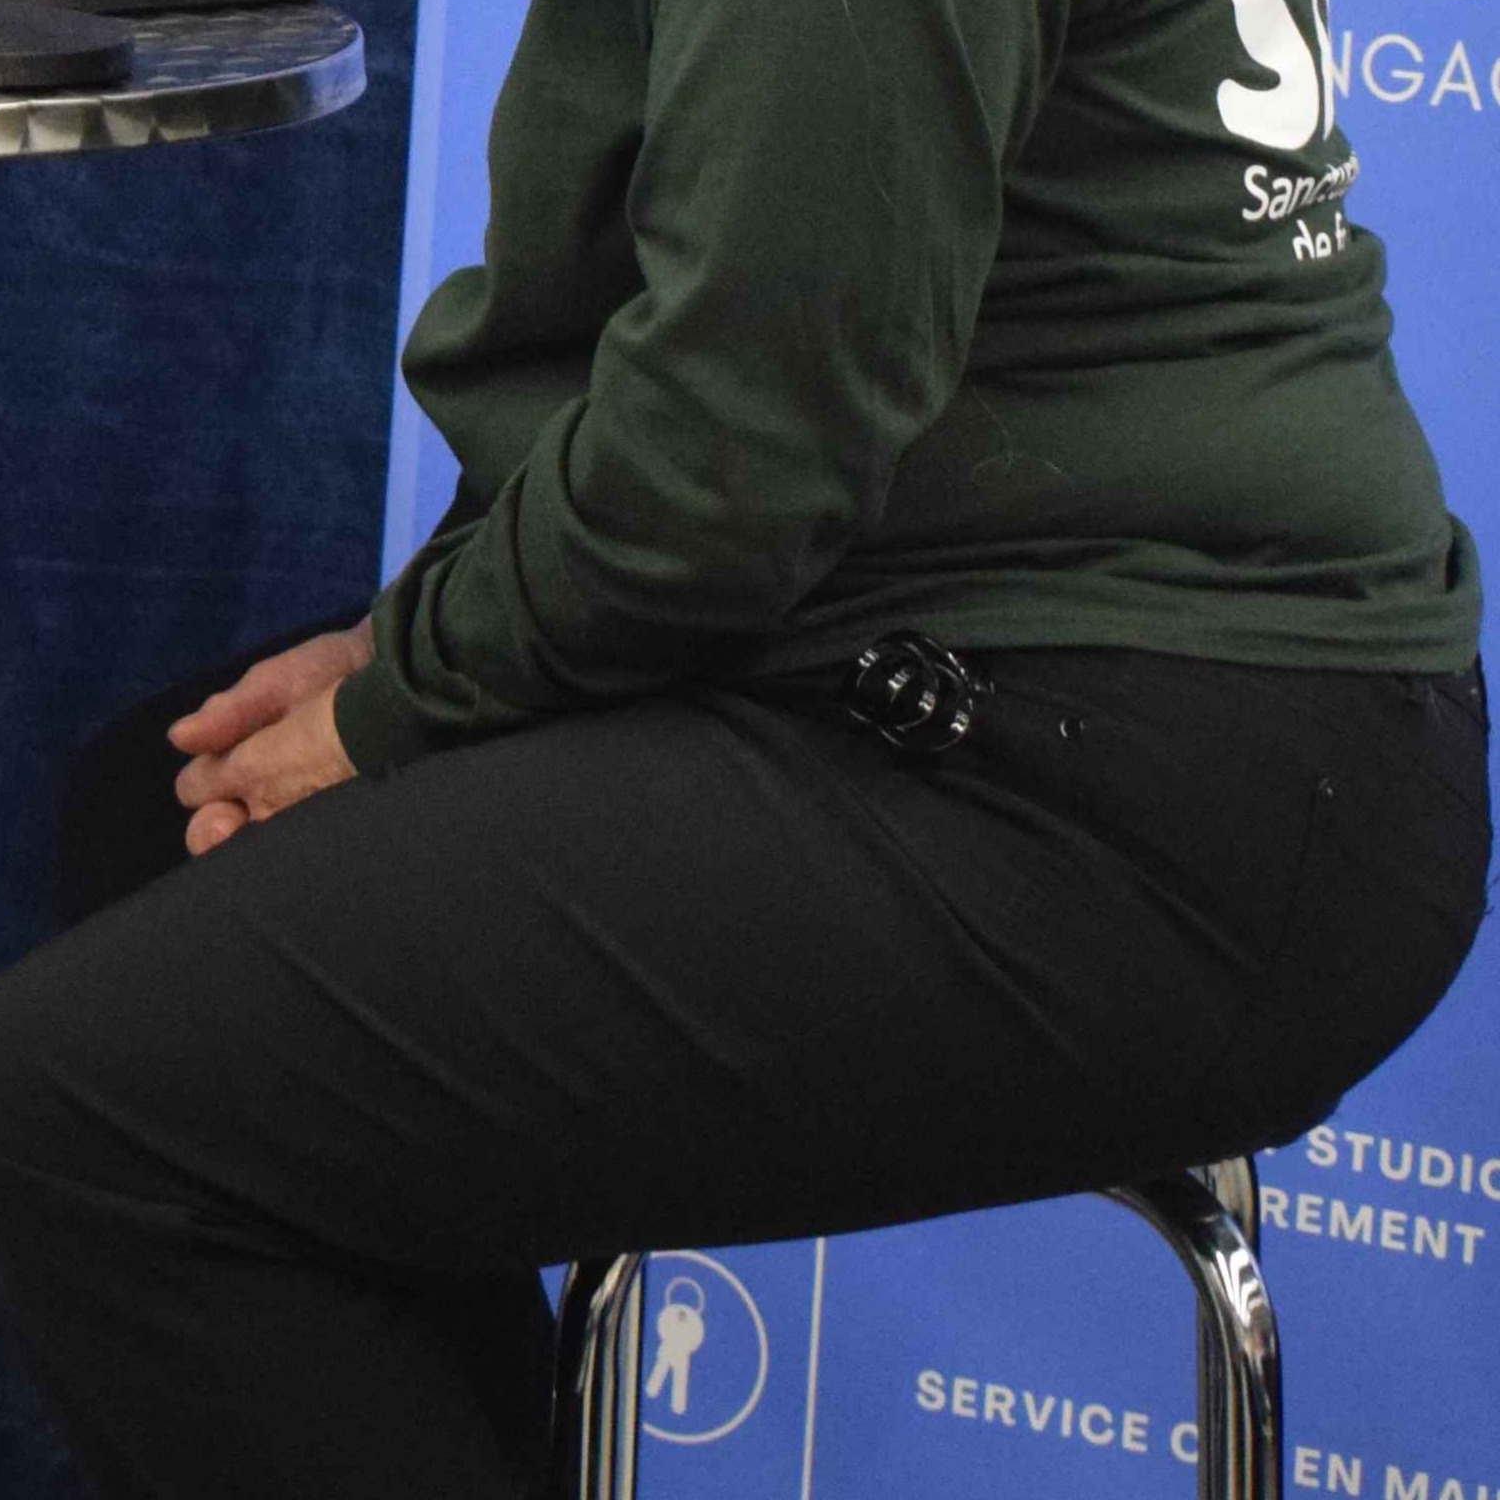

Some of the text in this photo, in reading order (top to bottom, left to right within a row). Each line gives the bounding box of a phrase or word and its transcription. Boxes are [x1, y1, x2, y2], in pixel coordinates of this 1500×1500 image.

[1259, 1186, 1485, 1265] REMENT
[916, 1370, 1149, 1452] SERVICE
[1294, 1446, 1361, 1496] EN
